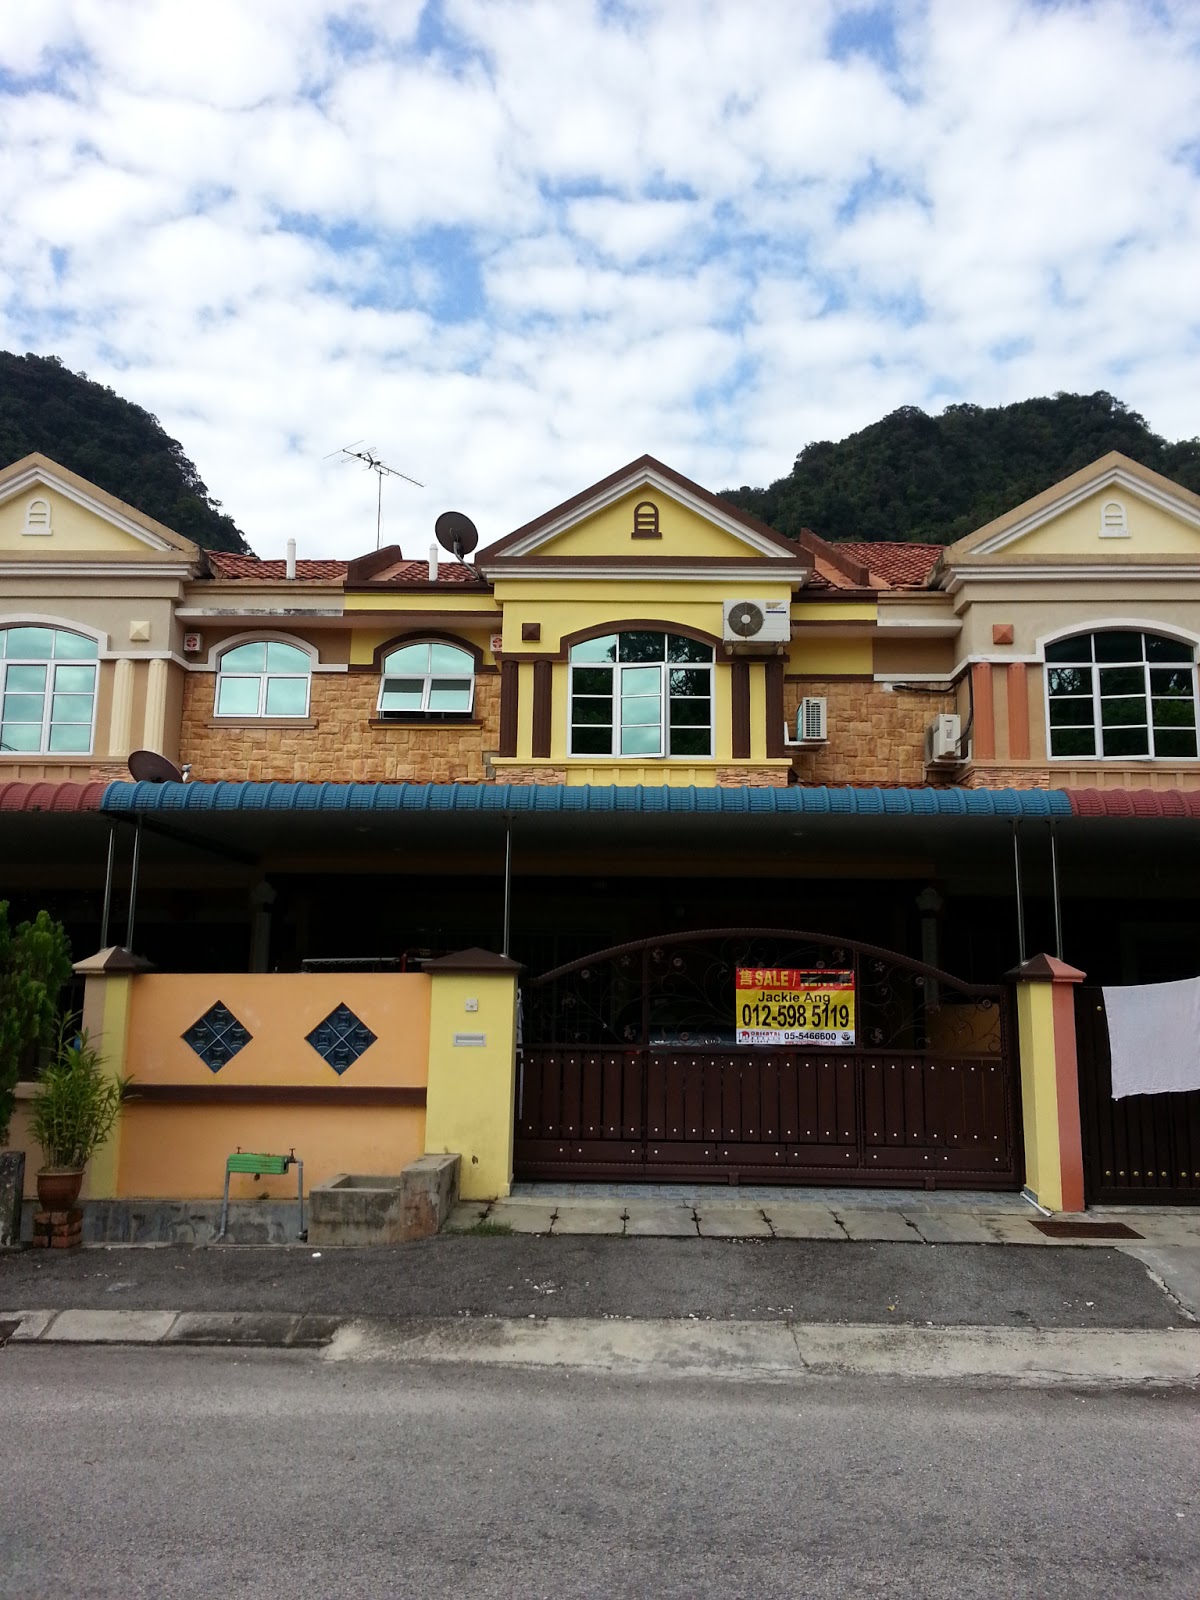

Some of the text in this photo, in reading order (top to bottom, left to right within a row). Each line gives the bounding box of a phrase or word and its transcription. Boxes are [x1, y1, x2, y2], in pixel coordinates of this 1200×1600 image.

[755, 970, 789, 987] SALE
[757, 991, 831, 1005] Jackie Ang
[742, 1003, 850, 1028] 012-598 5119
[784, 1032, 837, 1041] 05-5466600
